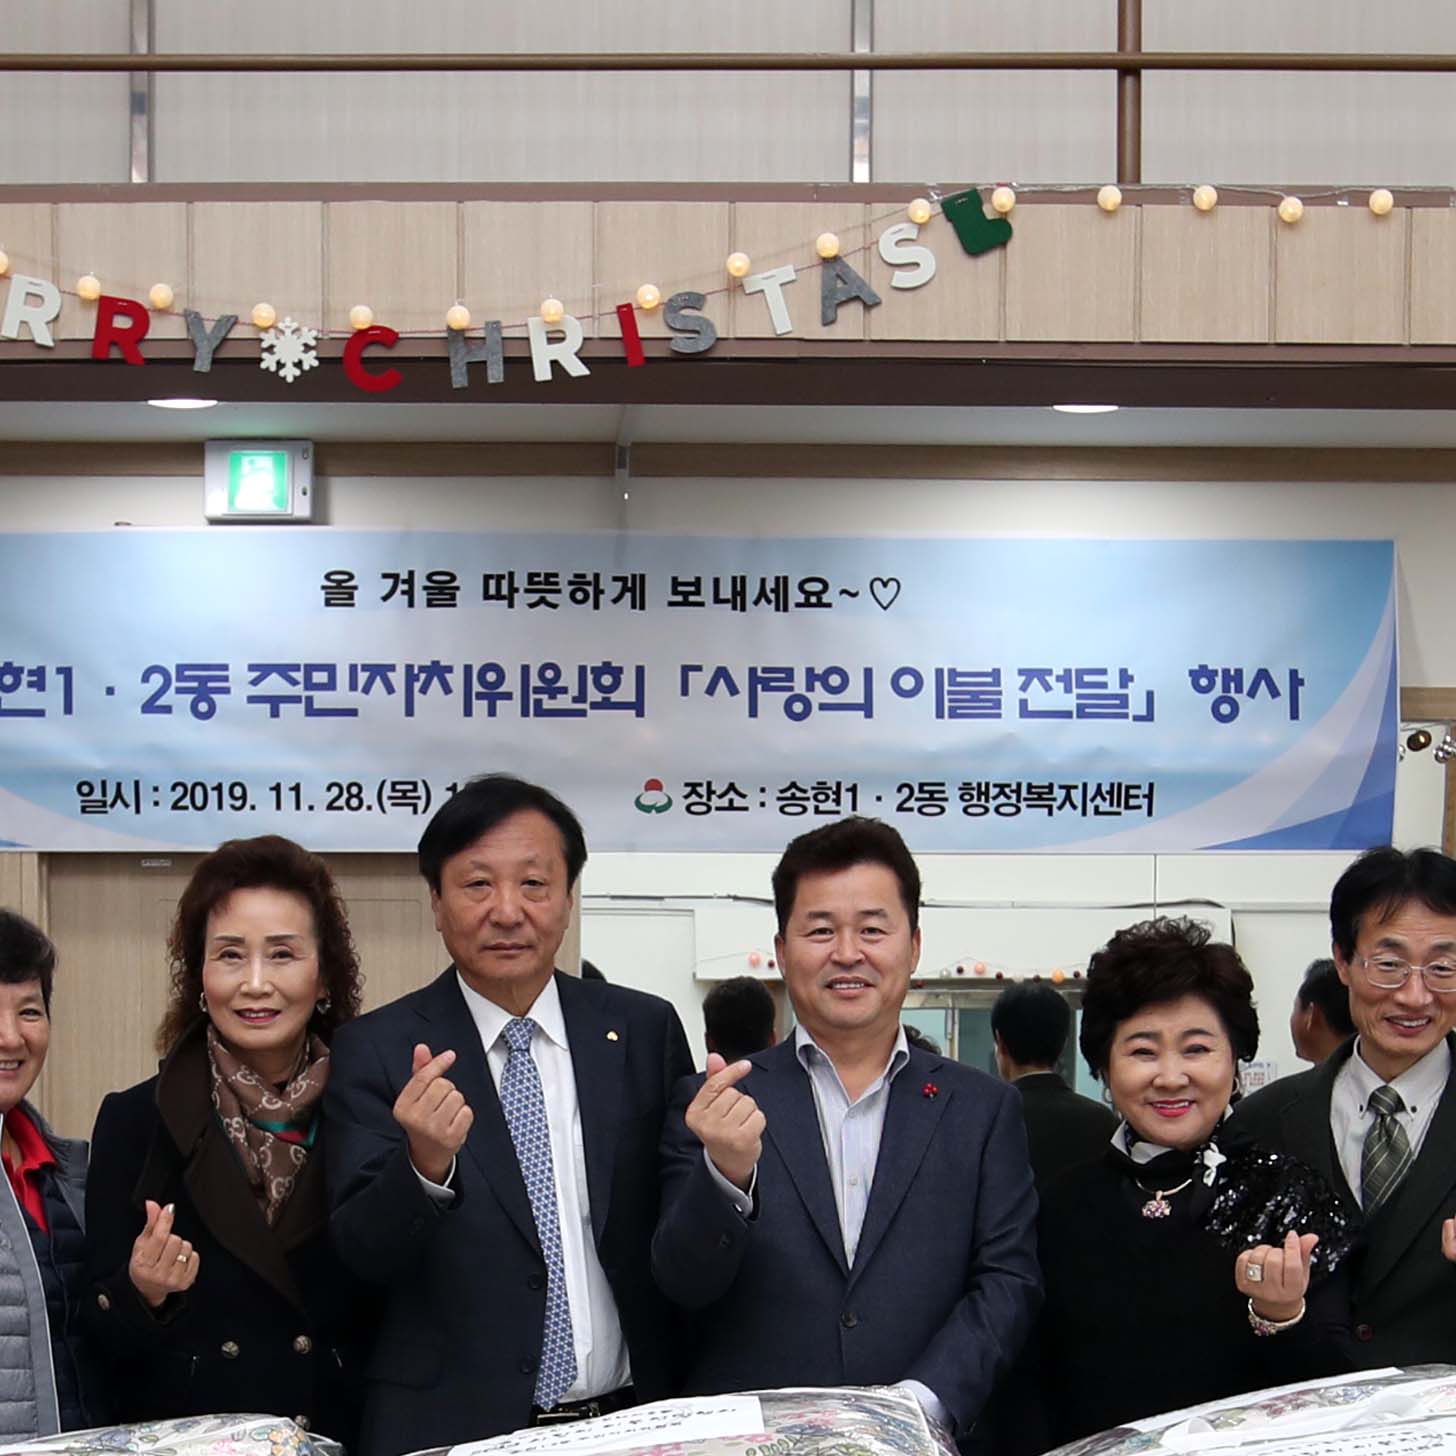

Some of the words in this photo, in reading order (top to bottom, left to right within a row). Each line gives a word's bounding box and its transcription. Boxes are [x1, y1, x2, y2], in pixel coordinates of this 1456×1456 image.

[320, 570, 359, 608] 올
[380, 569, 461, 609] 겨울
[482, 570, 647, 612] 따뜻하게
[246, 659, 646, 719] 주민자치위원회
[890, 666, 1003, 720] 이불
[1188, 664, 1305, 724] 행사
[170, 781, 256, 812] 2019.
[268, 782, 315, 811] 11.
[957, 781, 1155, 818] 행정복지센터
